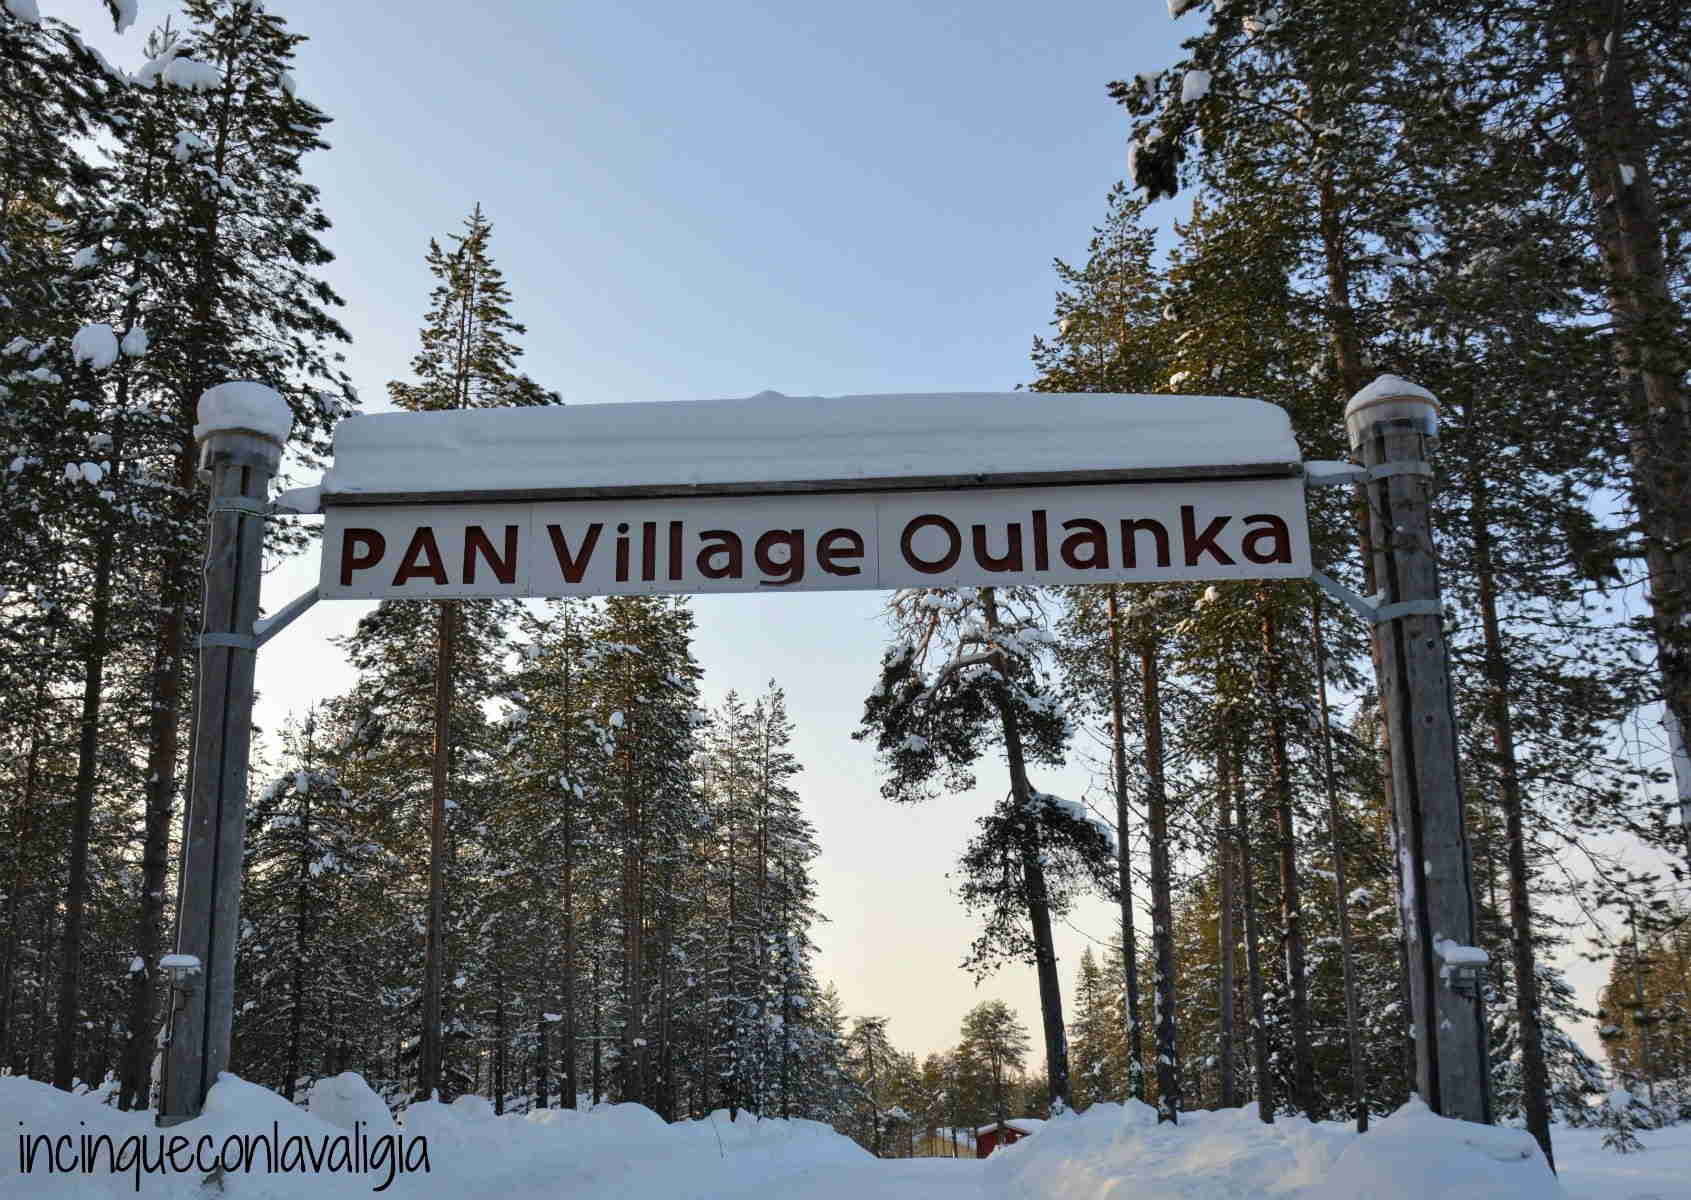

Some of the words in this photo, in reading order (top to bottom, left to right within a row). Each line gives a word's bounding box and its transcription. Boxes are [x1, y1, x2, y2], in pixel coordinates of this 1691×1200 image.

[340, 524, 520, 587] PAN
[546, 520, 865, 588] Village
[899, 505, 1293, 575] Oulanka
